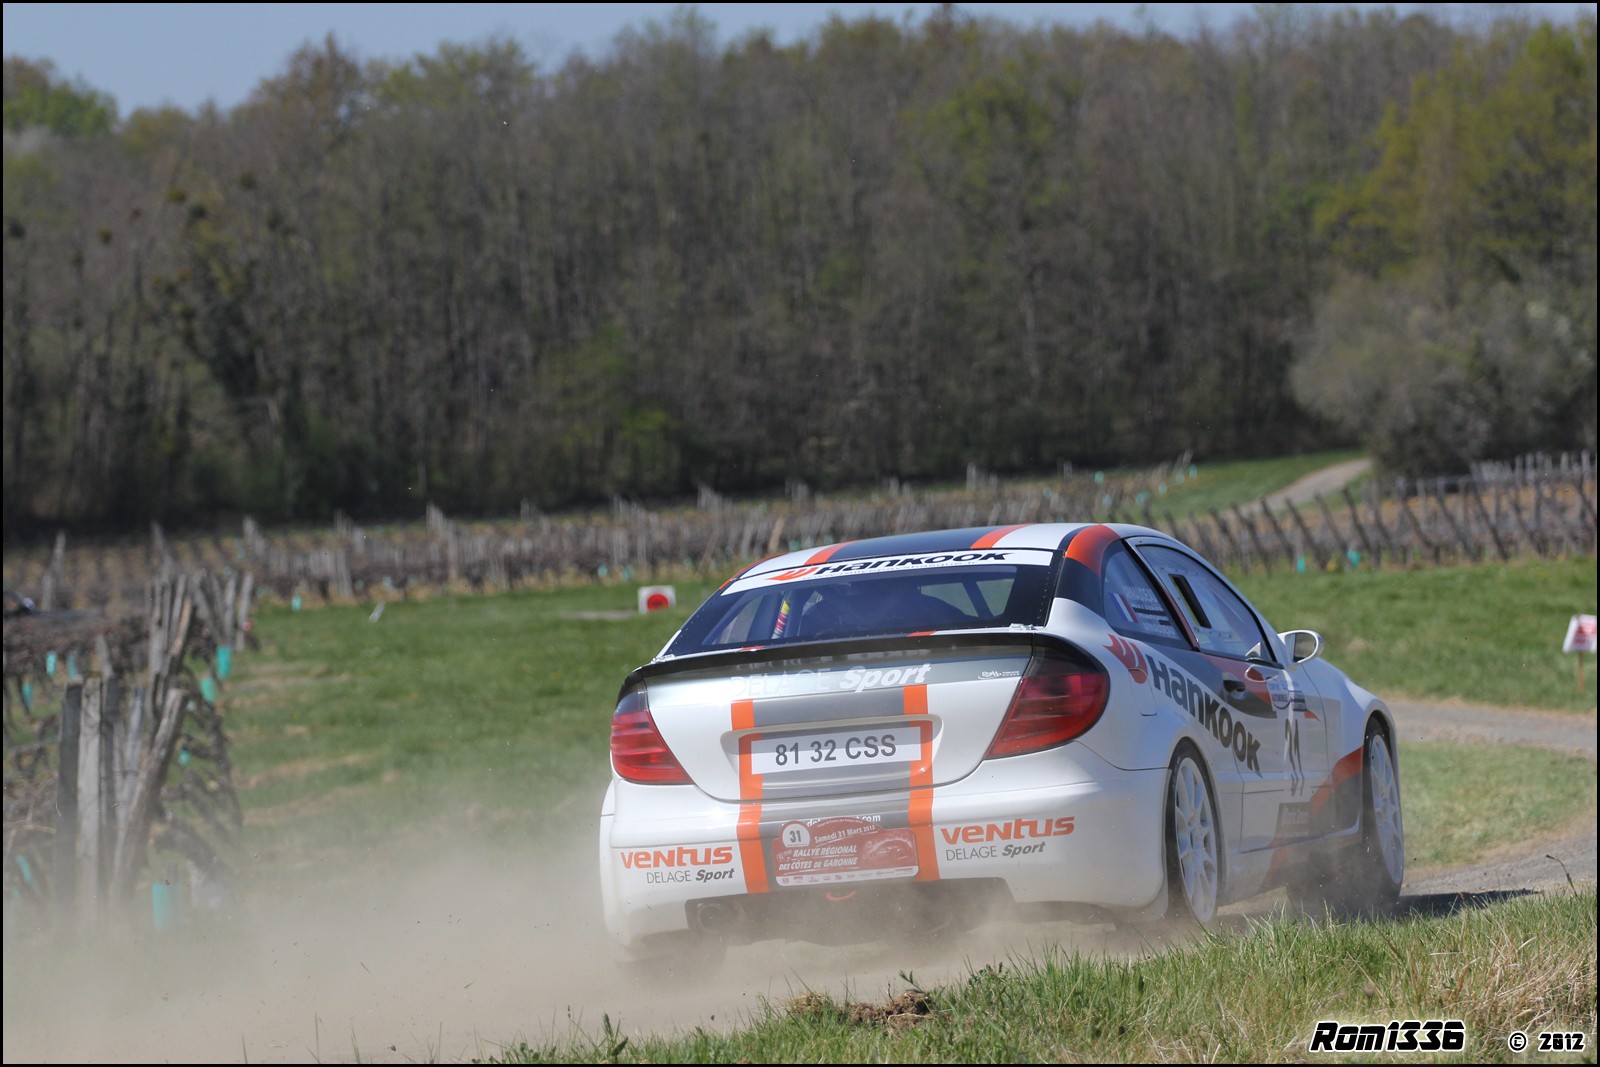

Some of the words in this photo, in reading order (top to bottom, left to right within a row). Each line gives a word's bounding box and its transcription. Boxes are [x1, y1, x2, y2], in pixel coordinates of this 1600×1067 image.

[839, 663, 931, 693] Sport
[775, 743, 799, 766] 81
[810, 739, 837, 762] 32
[845, 734, 896, 759] CSS
[789, 830, 802, 843] 31
[814, 832, 837, 843] Samedi
[838, 830, 846, 838] 31
[847, 827, 862, 837] Mars
[793, 848, 820, 858] RALLYE
[946, 846, 998, 861] DELAGE
[1002, 841, 1046, 858] Sport
[779, 863, 790, 871] DES
[790, 860, 812, 870] CÔTES
[823, 857, 858, 867] GARONNE
[646, 870, 692, 884] DELAGE
[695, 867, 735, 882] Sport
